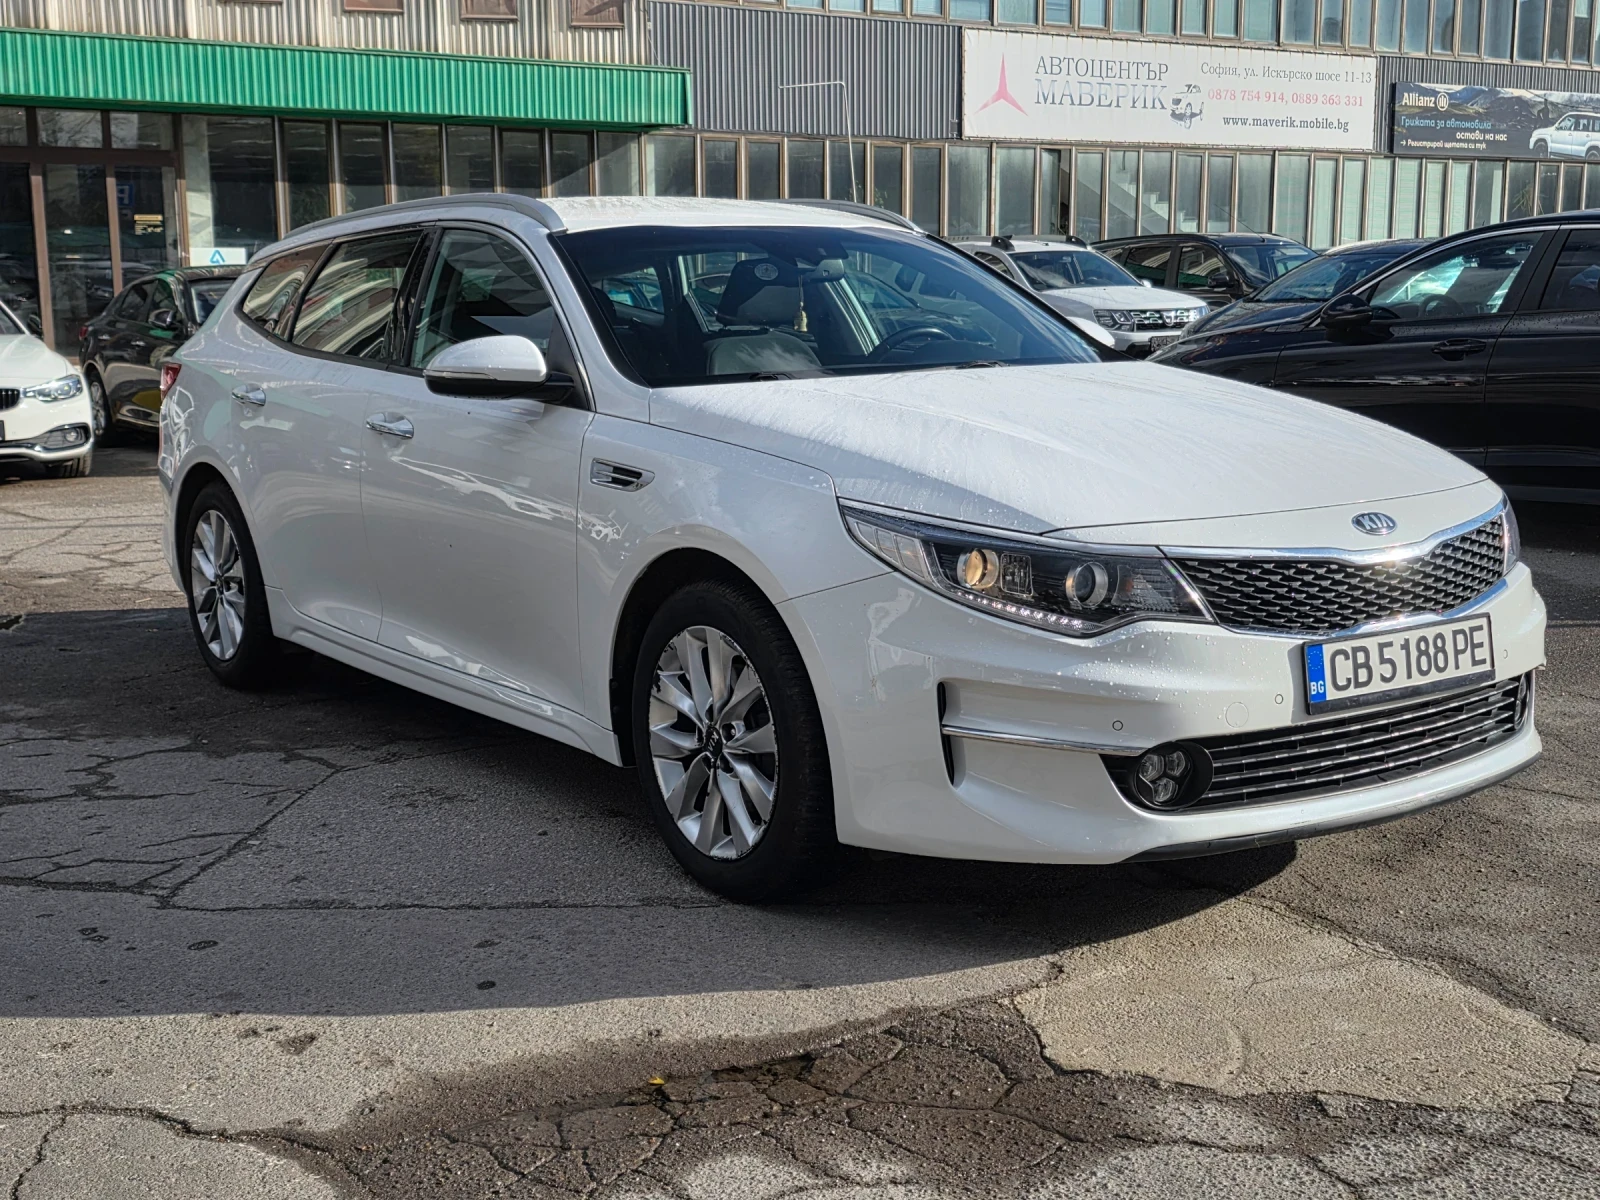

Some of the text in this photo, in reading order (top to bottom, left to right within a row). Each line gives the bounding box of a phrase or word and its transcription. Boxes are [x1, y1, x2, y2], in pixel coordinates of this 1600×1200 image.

[1035, 55, 1169, 81] АВТОЦЕНТЪР
[1200, 62, 1372, 84] София, ул. Искърско шосе 11-13
[1034, 78, 1168, 110] МАВЕРИК
[1207, 88, 1364, 107] 0878 754 914, 0889 363 331
[1402, 92, 1436, 107] Allianz
[1222, 116, 1350, 133] www.maverik.mobile.bg
[1401, 115, 1492, 129] Грижата за автомобила
[1456, 130, 1508, 141] остави на нас
[1357, 513, 1394, 530] KIA
[1310, 680, 1325, 695] BG
[707, 731, 719, 752] KIA
